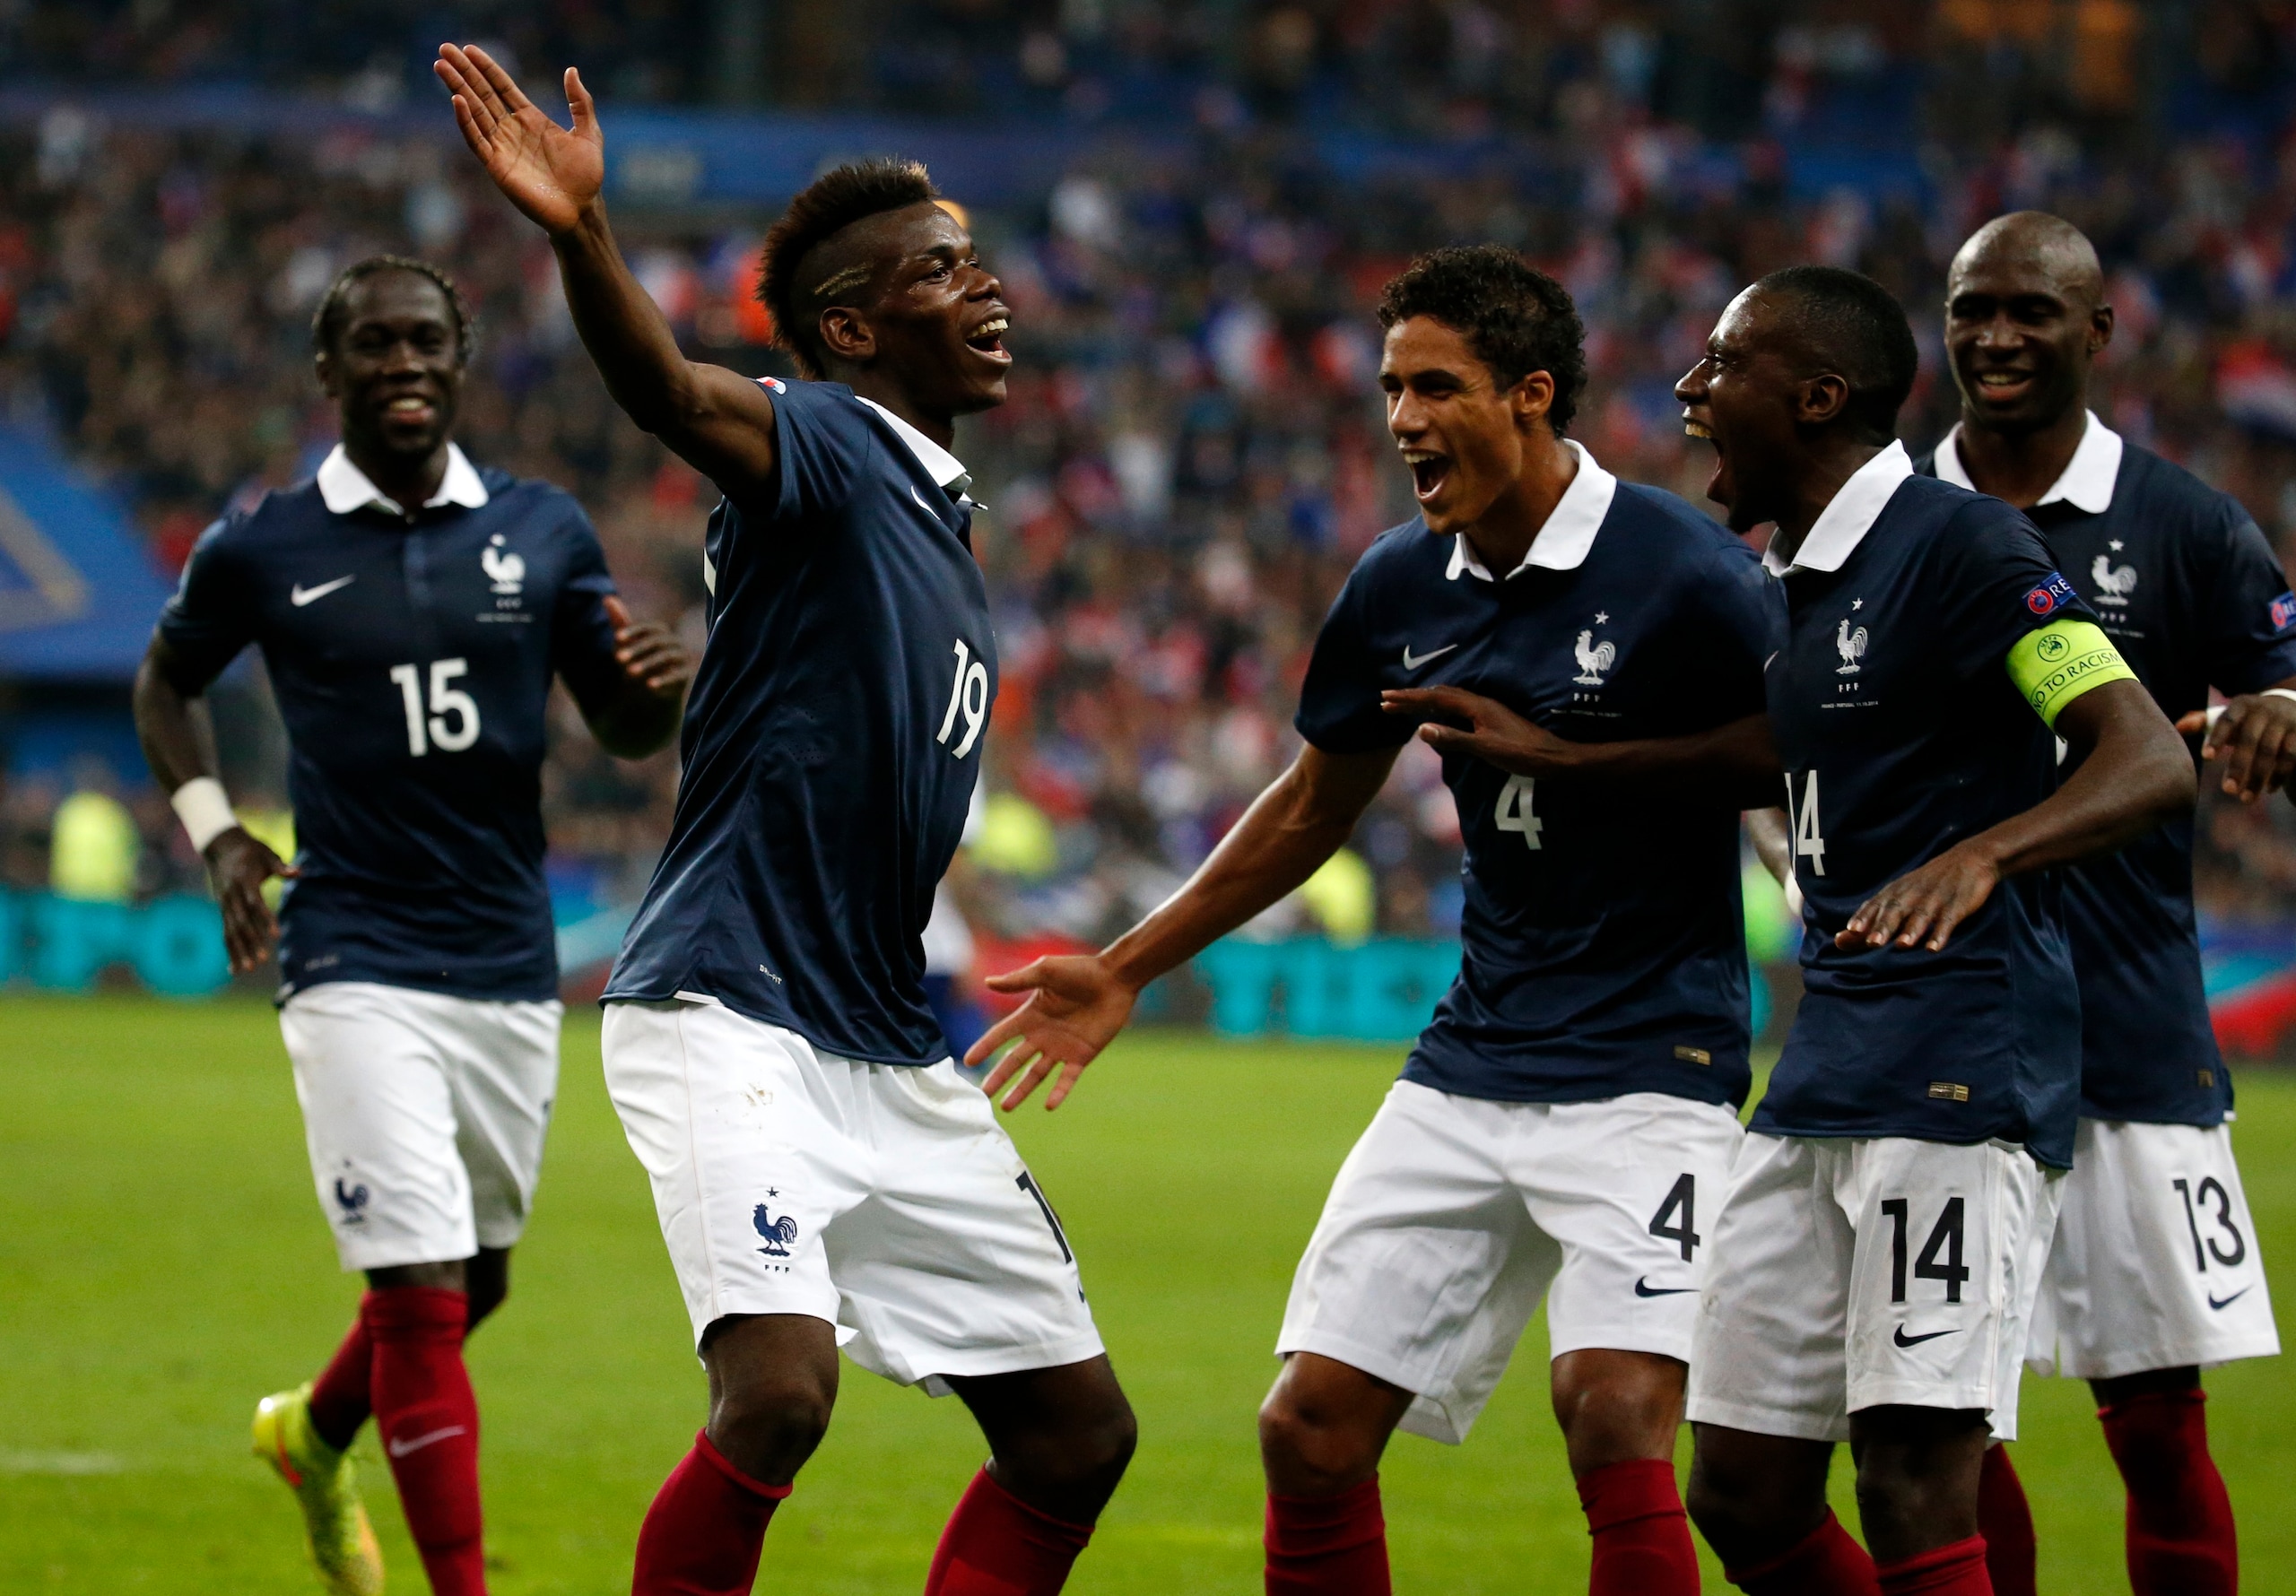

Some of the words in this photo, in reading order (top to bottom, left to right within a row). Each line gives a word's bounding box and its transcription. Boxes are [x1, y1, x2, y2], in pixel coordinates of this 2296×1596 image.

[390, 658, 481, 756] 15
[935, 638, 987, 759] 19
[2044, 673, 2065, 691] TO
[2066, 652, 2122, 677] RACISM
[1494, 774, 1544, 850] 4
[1648, 1173, 1700, 1262] 4
[1881, 1196, 1970, 1304] 14
[2173, 1176, 2245, 1271] 13
[764, 1264, 790, 1274] FFF
